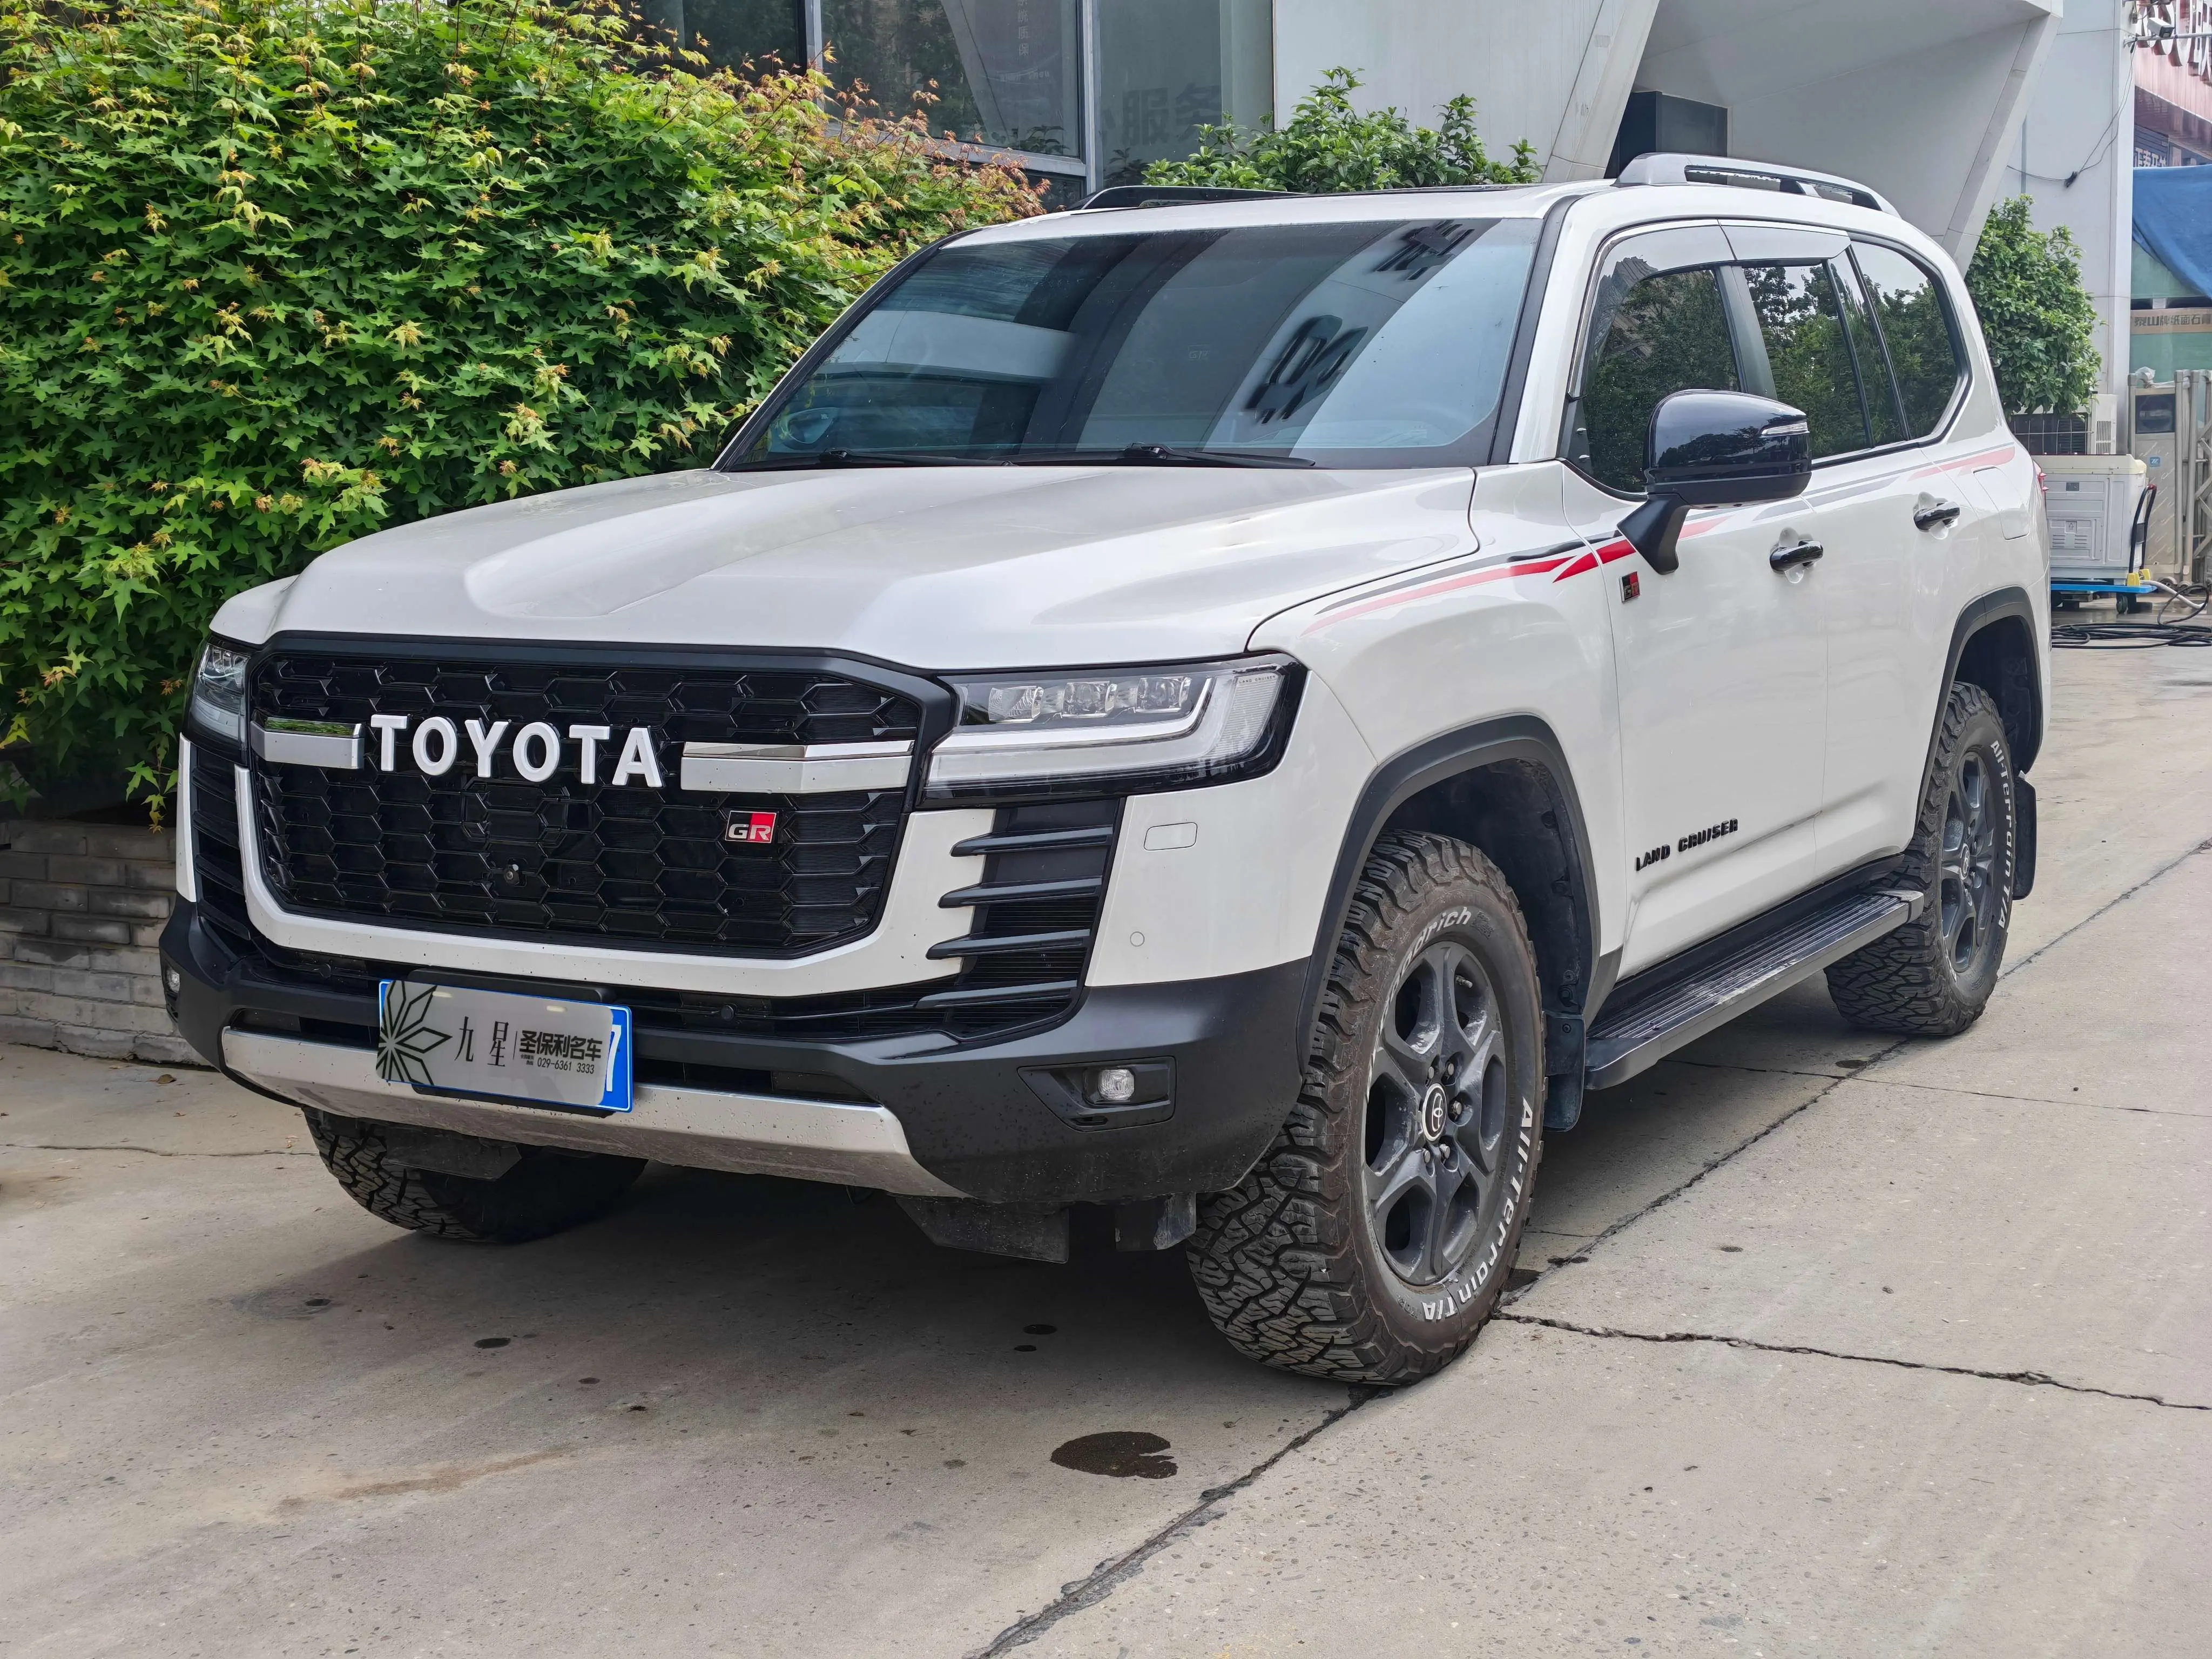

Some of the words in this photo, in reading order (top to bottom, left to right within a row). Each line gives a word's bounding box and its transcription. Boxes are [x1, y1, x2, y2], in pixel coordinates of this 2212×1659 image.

[370, 714, 663, 788] TOYOTA
[729, 824, 771, 841] GR
[1636, 844, 1670, 872] LAND
[1678, 818, 1738, 852] CRUISER
[454, 1016, 509, 1067] 九星
[519, 1030, 603, 1062] 圣保利名车
[537, 1057, 571, 1071] 029-6361
[576, 1062, 595, 1074] 3333
[1459, 1097, 1533, 1304] All-Terrain
[1422, 1296, 1458, 1320] T/A
